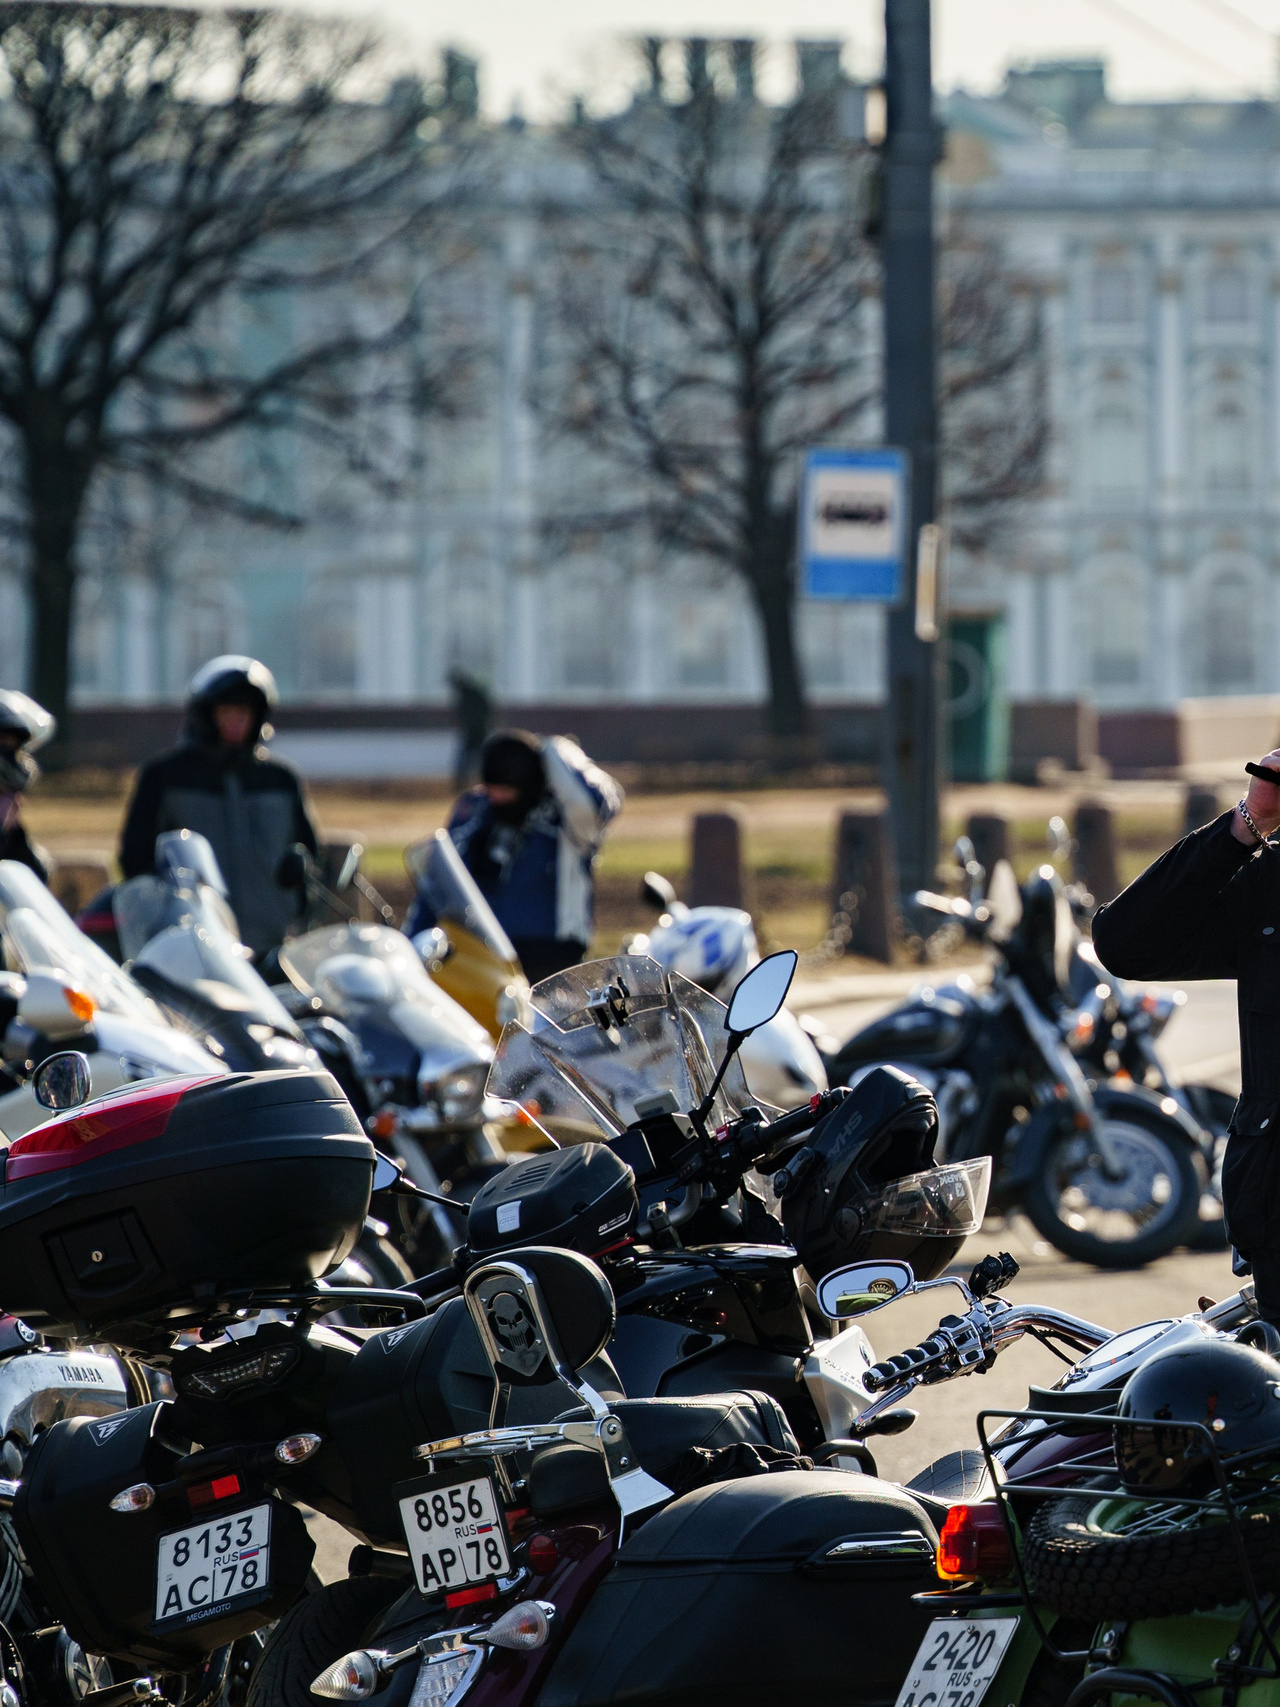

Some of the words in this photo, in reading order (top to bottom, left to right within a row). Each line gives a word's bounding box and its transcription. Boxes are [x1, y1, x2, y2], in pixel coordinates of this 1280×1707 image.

[57, 1365, 104, 1383] YAMAHA
[414, 1485, 483, 1532] 8856
[172, 1515, 253, 1567] 8133
[454, 1524, 477, 1539] RUS
[213, 1551, 239, 1568] RUS
[421, 1547, 457, 1588] AP
[465, 1537, 502, 1571] 78
[162, 1575, 209, 1616] AC
[220, 1560, 258, 1597] 78
[186, 1602, 231, 1622] MEGAMOTO
[922, 1629, 996, 1671] 2420
[946, 1671, 973, 1687] RUS
